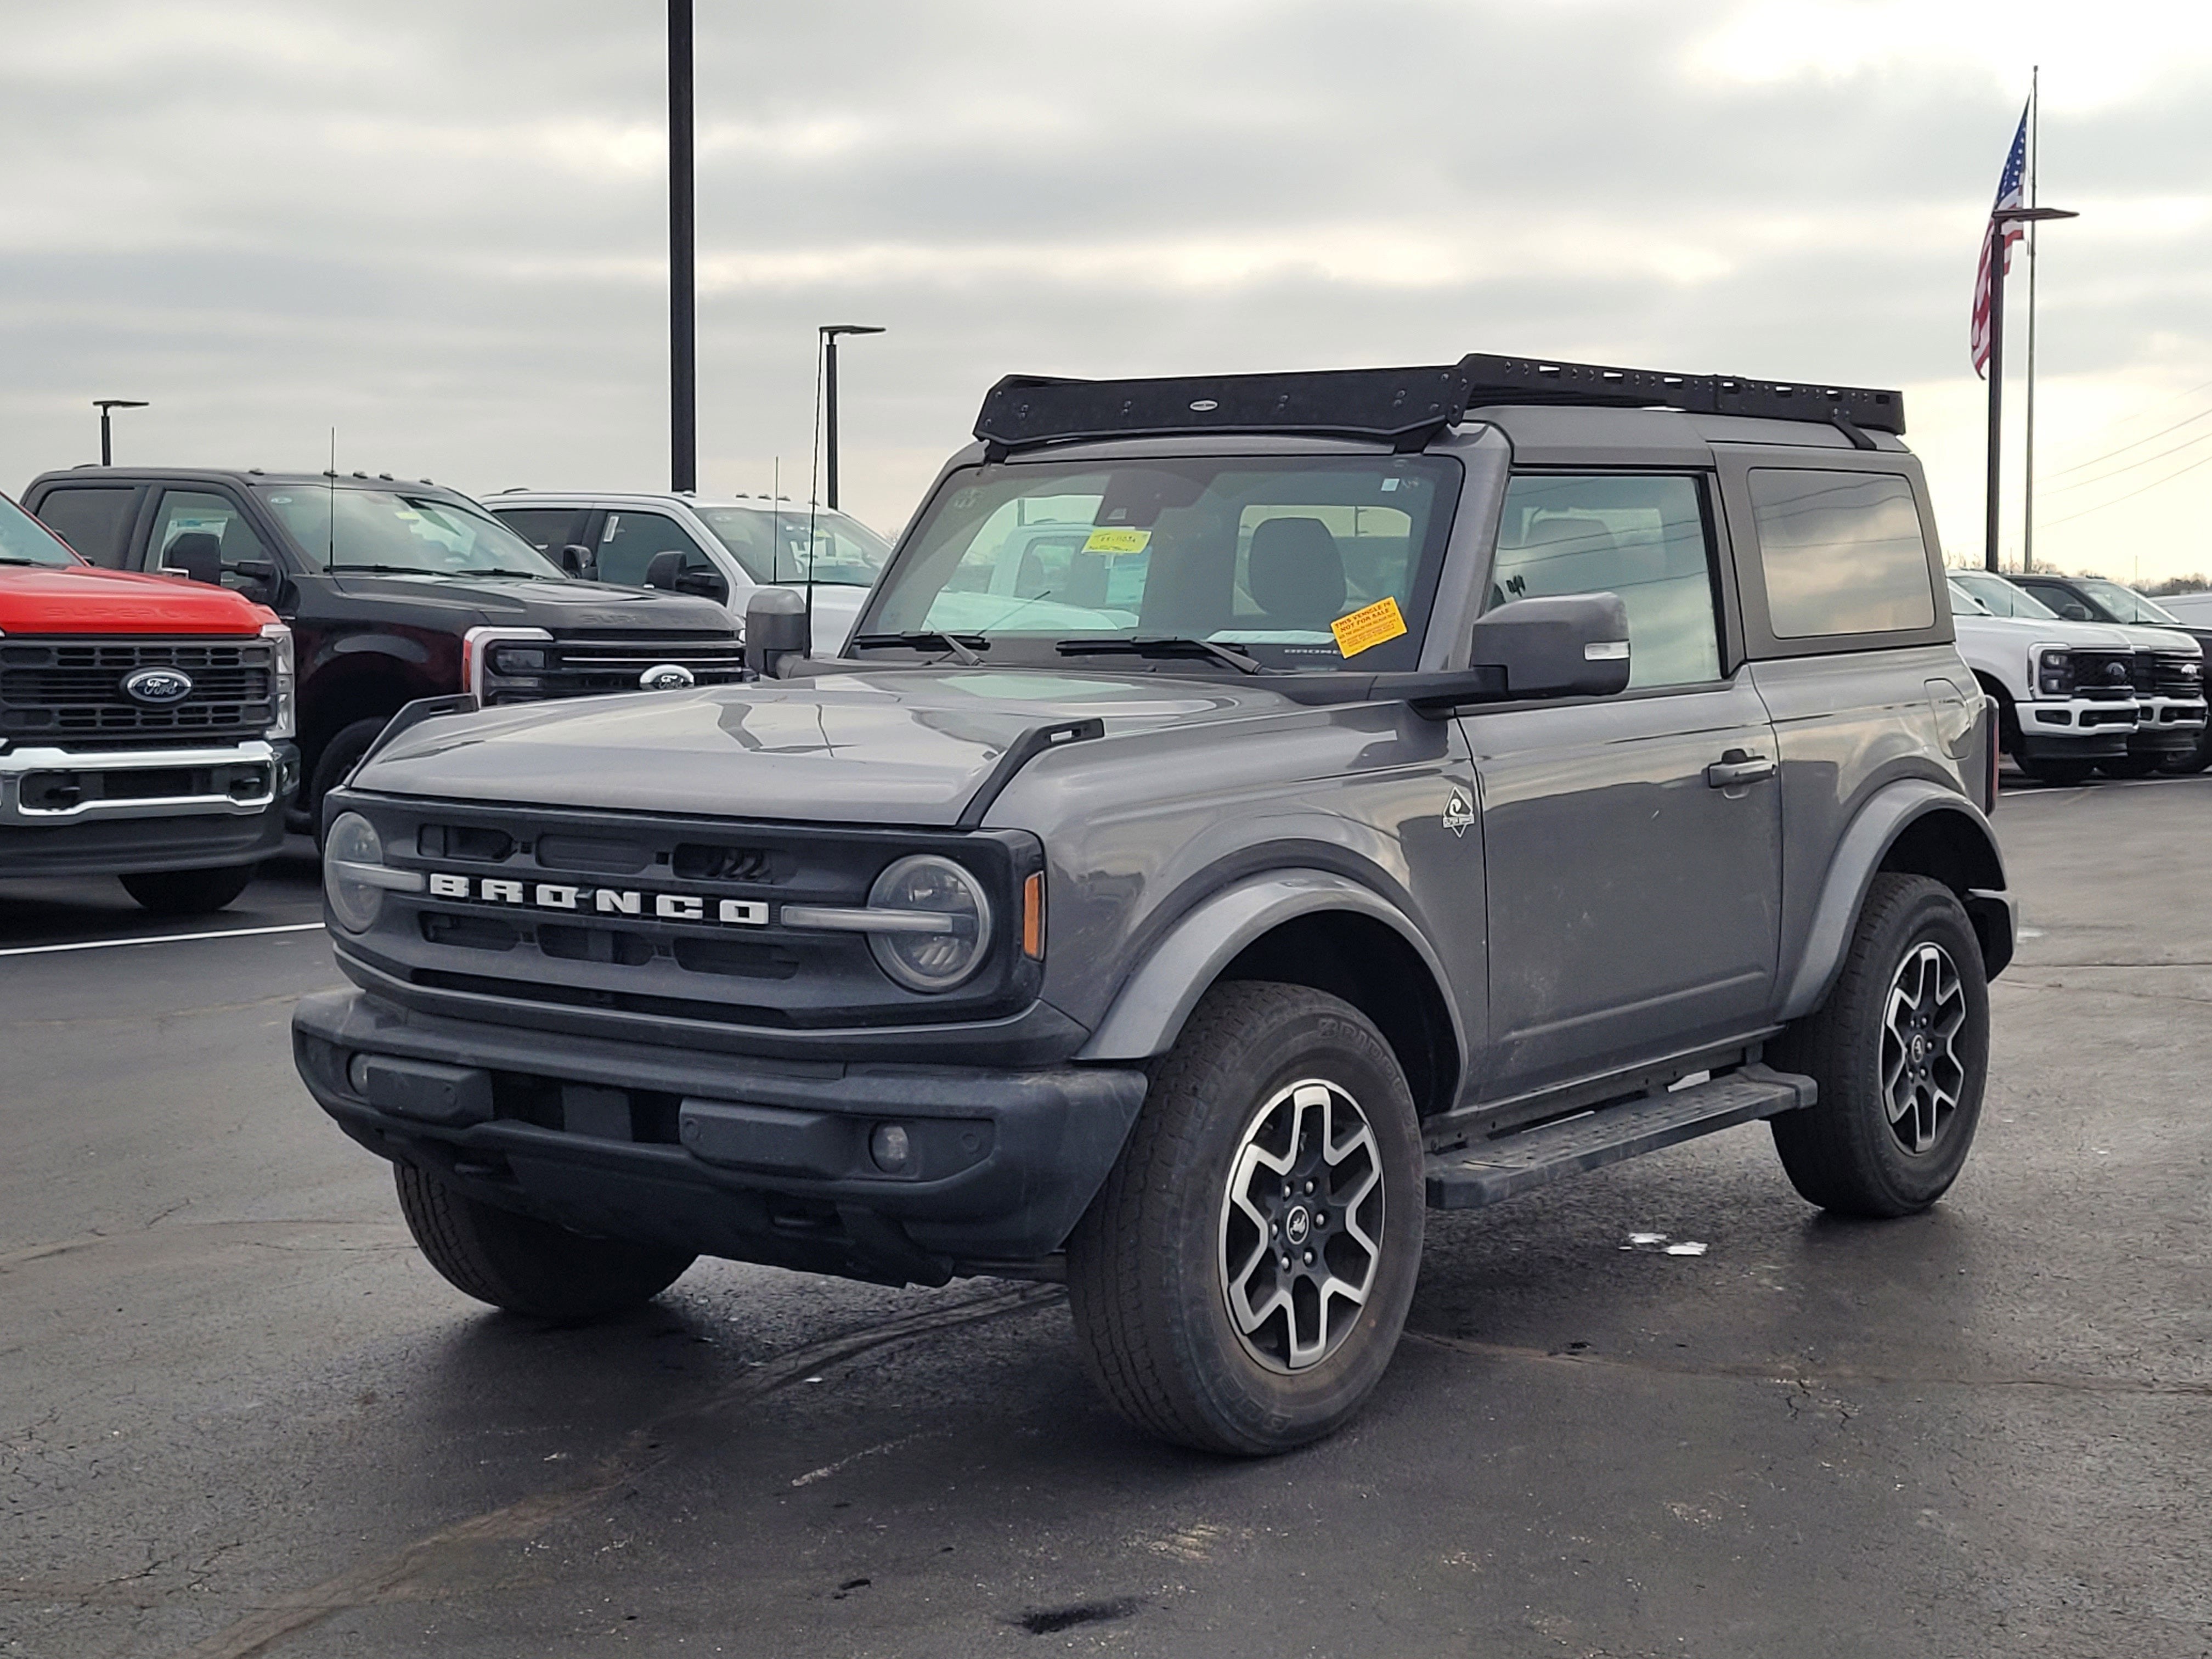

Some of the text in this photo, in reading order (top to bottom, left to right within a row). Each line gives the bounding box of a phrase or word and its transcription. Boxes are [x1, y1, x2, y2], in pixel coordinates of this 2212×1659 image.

[1335, 618, 1351, 628] THIS
[1353, 605, 1381, 619] VEHICLE
[1340, 608, 1389, 632] NOT FOR SALE
[144, 678, 179, 695] Ford
[430, 873, 769, 925] BRONCO
